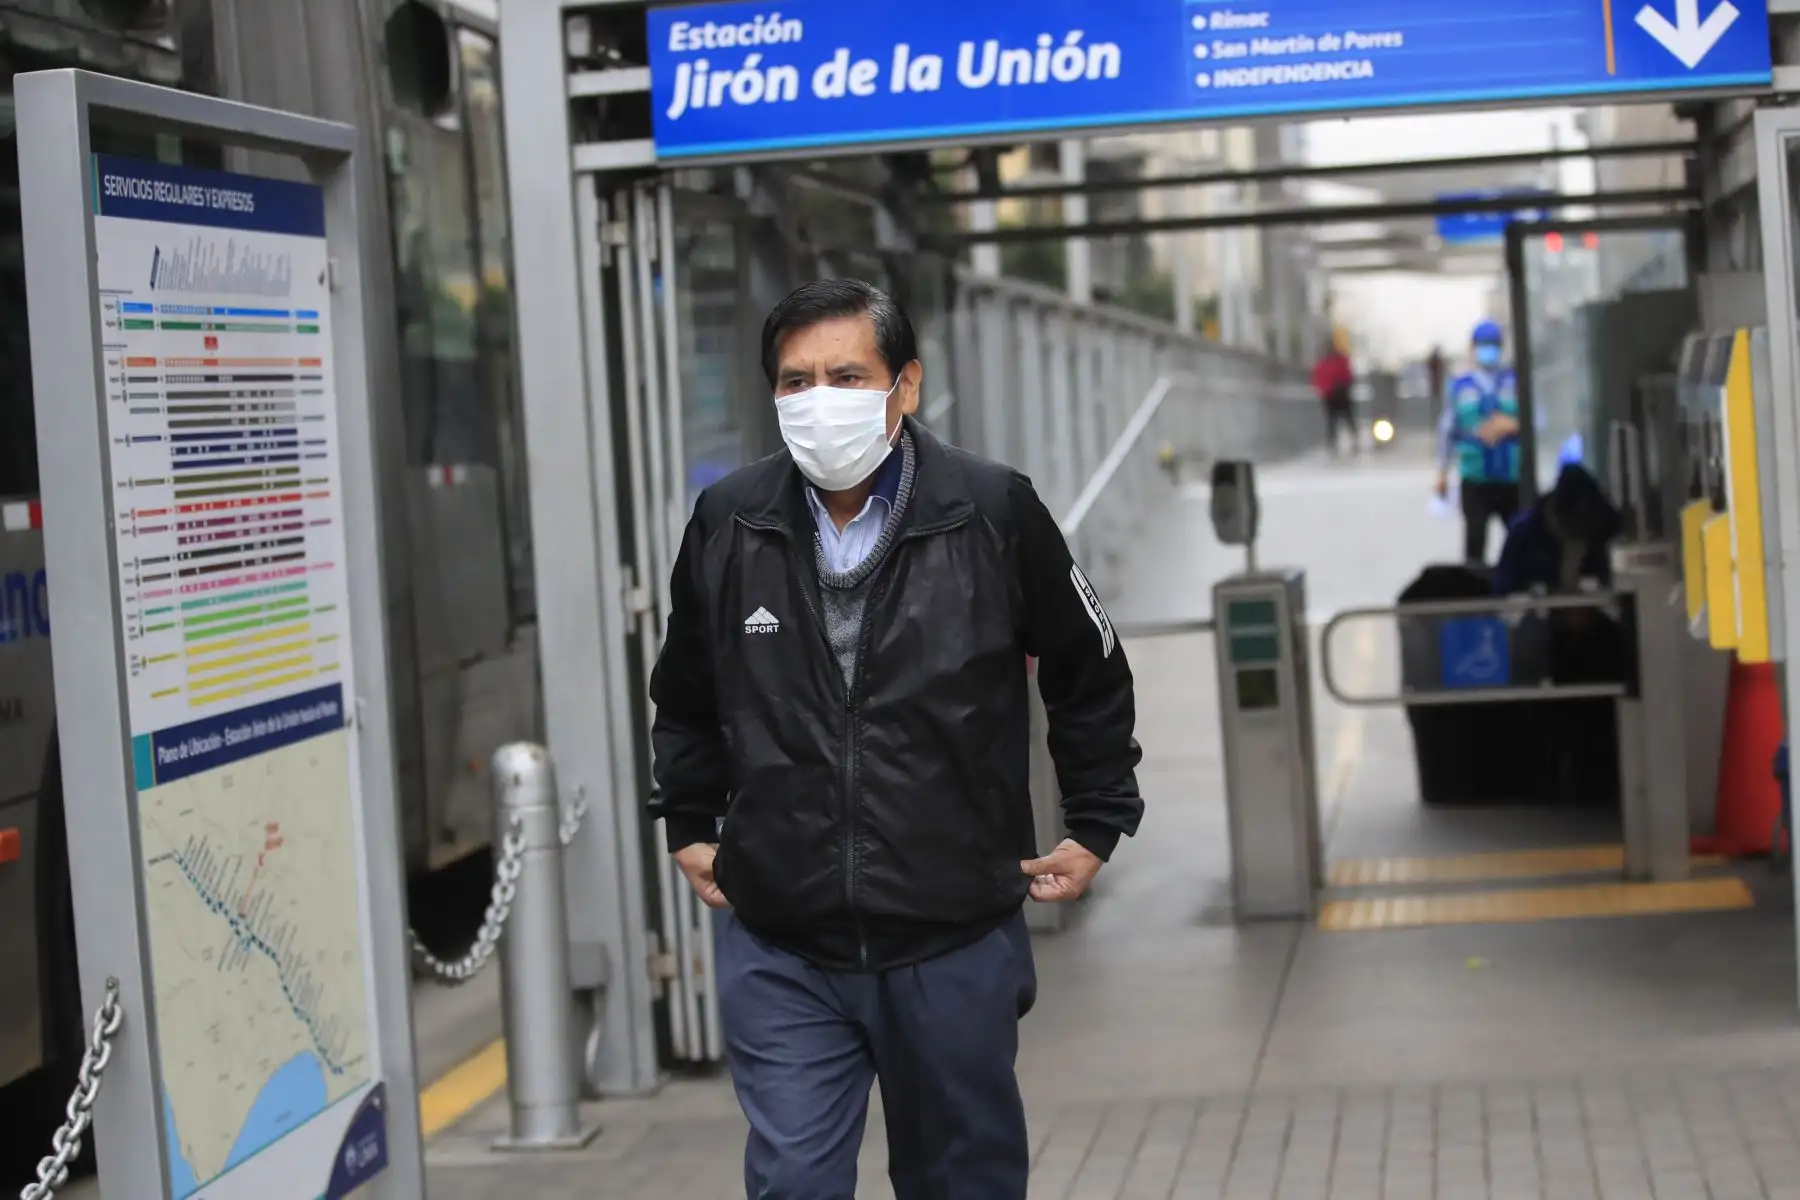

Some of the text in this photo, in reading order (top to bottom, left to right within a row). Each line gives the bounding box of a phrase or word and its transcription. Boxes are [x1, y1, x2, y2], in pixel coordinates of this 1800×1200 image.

[668, 12, 803, 52] Estación
[1212, 40, 1248, 59] San
[1317, 32, 1342, 51] de
[1344, 30, 1403, 51] Porres
[666, 29, 1121, 120] Jirón de la Unión
[1213, 60, 1374, 88] INDEPENDENCIA
[104, 174, 255, 212] SERVICIOS REGULARES Y EXPRESOS
[745, 625, 779, 634] SPORT
